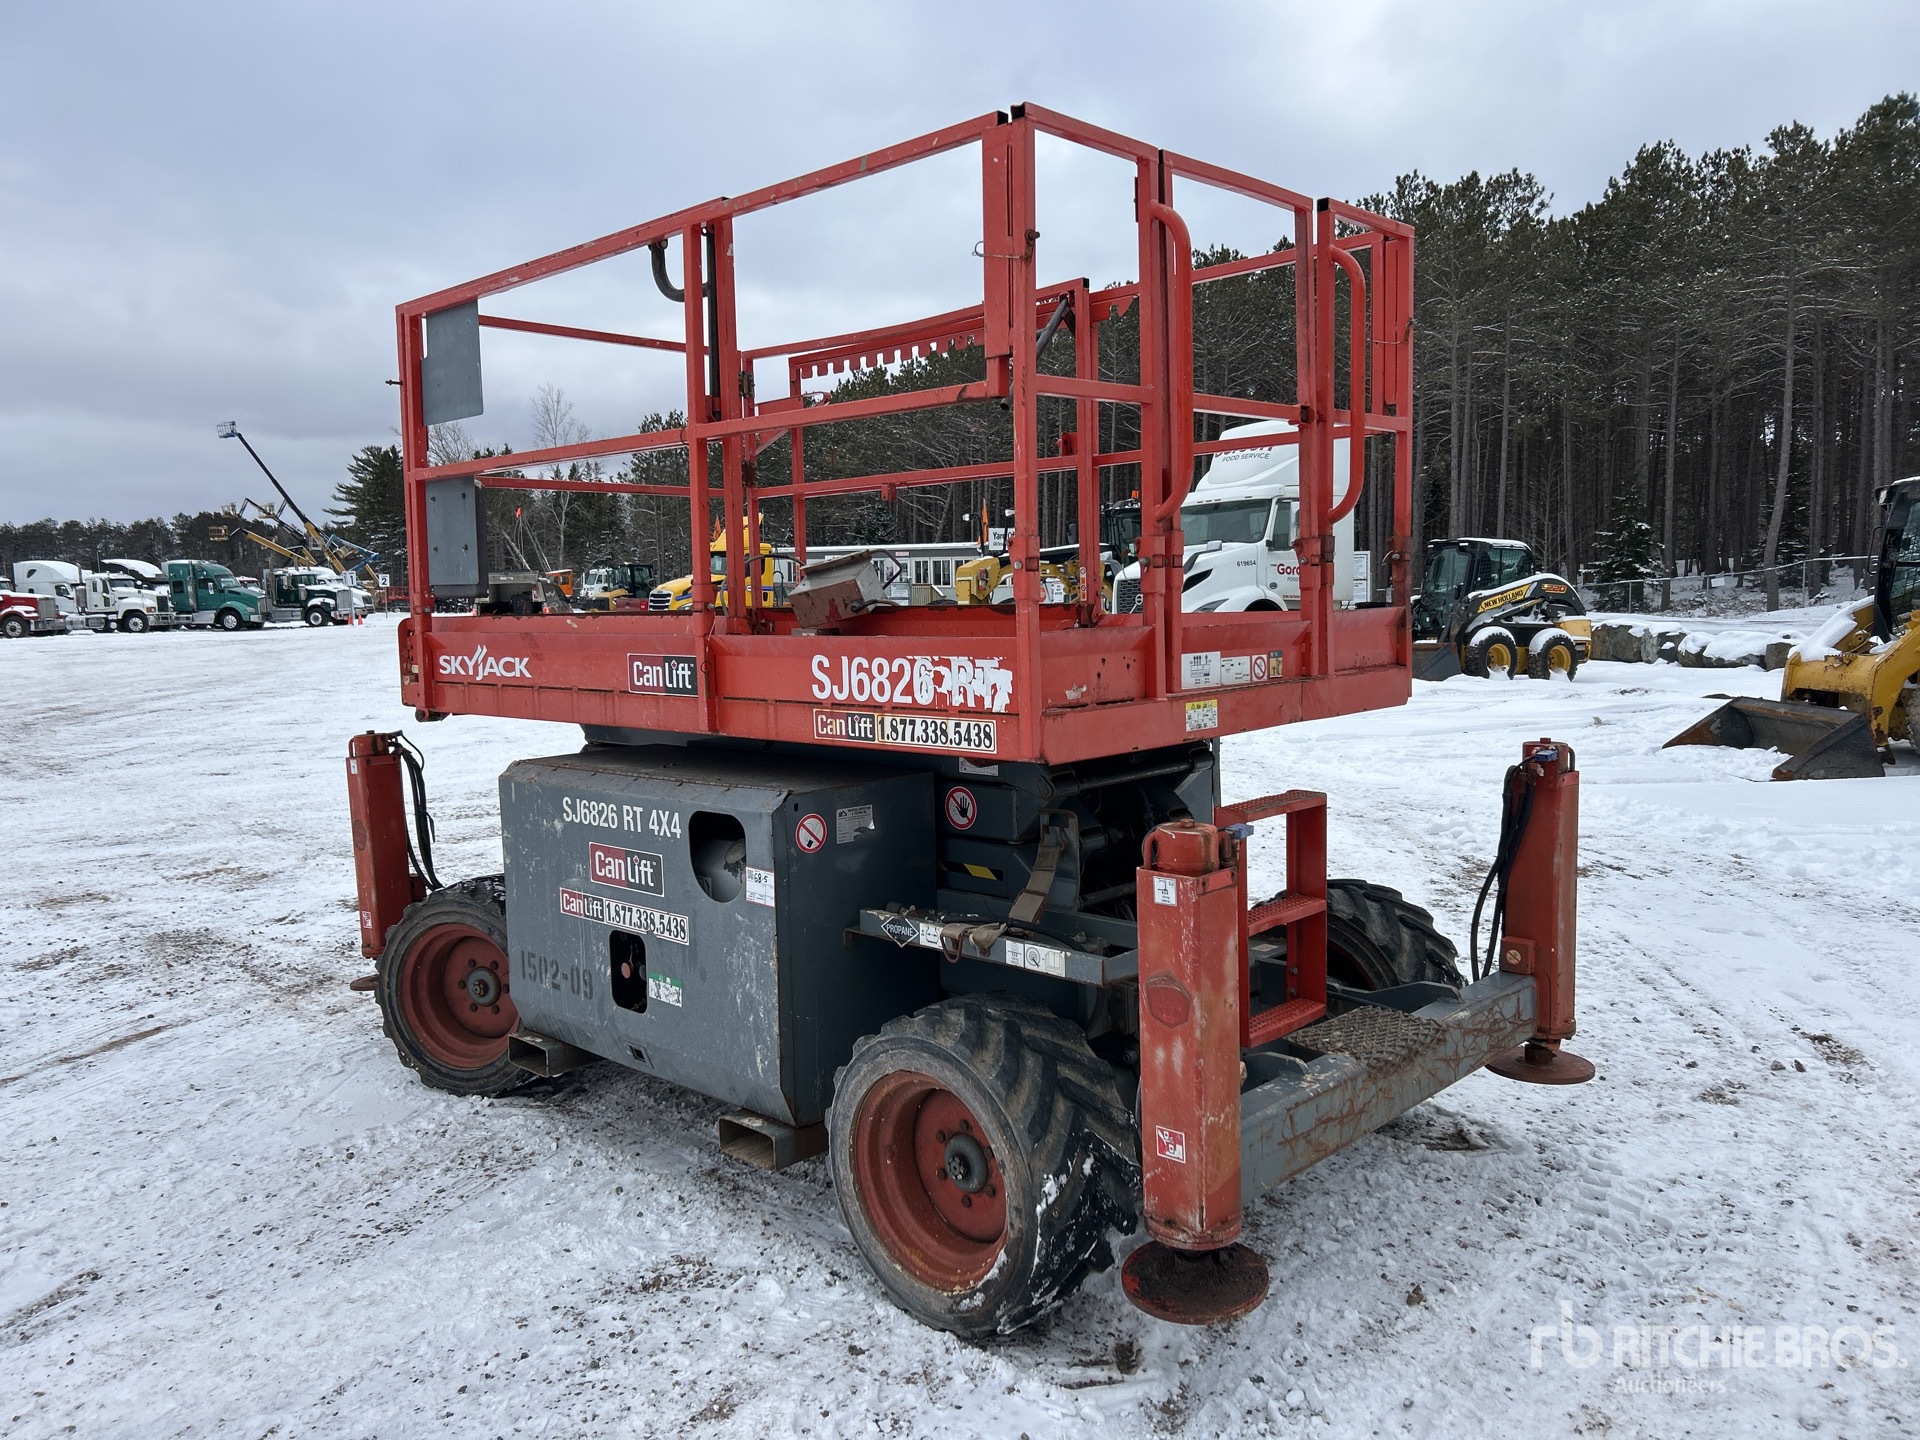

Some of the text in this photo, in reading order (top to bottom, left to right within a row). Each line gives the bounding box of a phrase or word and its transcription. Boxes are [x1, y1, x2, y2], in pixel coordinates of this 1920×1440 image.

[1222, 452, 1271, 462] FOOD SERVICE
[1236, 559, 1257, 567] 619654
[381, 577, 387, 586] 2
[1484, 589, 1524, 609] NEW HOLLAND
[439, 643, 532, 681] SKYJACK
[811, 655, 935, 705] SJ6826
[878, 716, 993, 749] 1.877.338.5438
[562, 796, 681, 838] SJ6826 RT 4X4
[606, 902, 687, 941] 1.877.338.5438
[886, 923, 914, 937] PROPANE
[521, 950, 593, 1000] 1502-09
